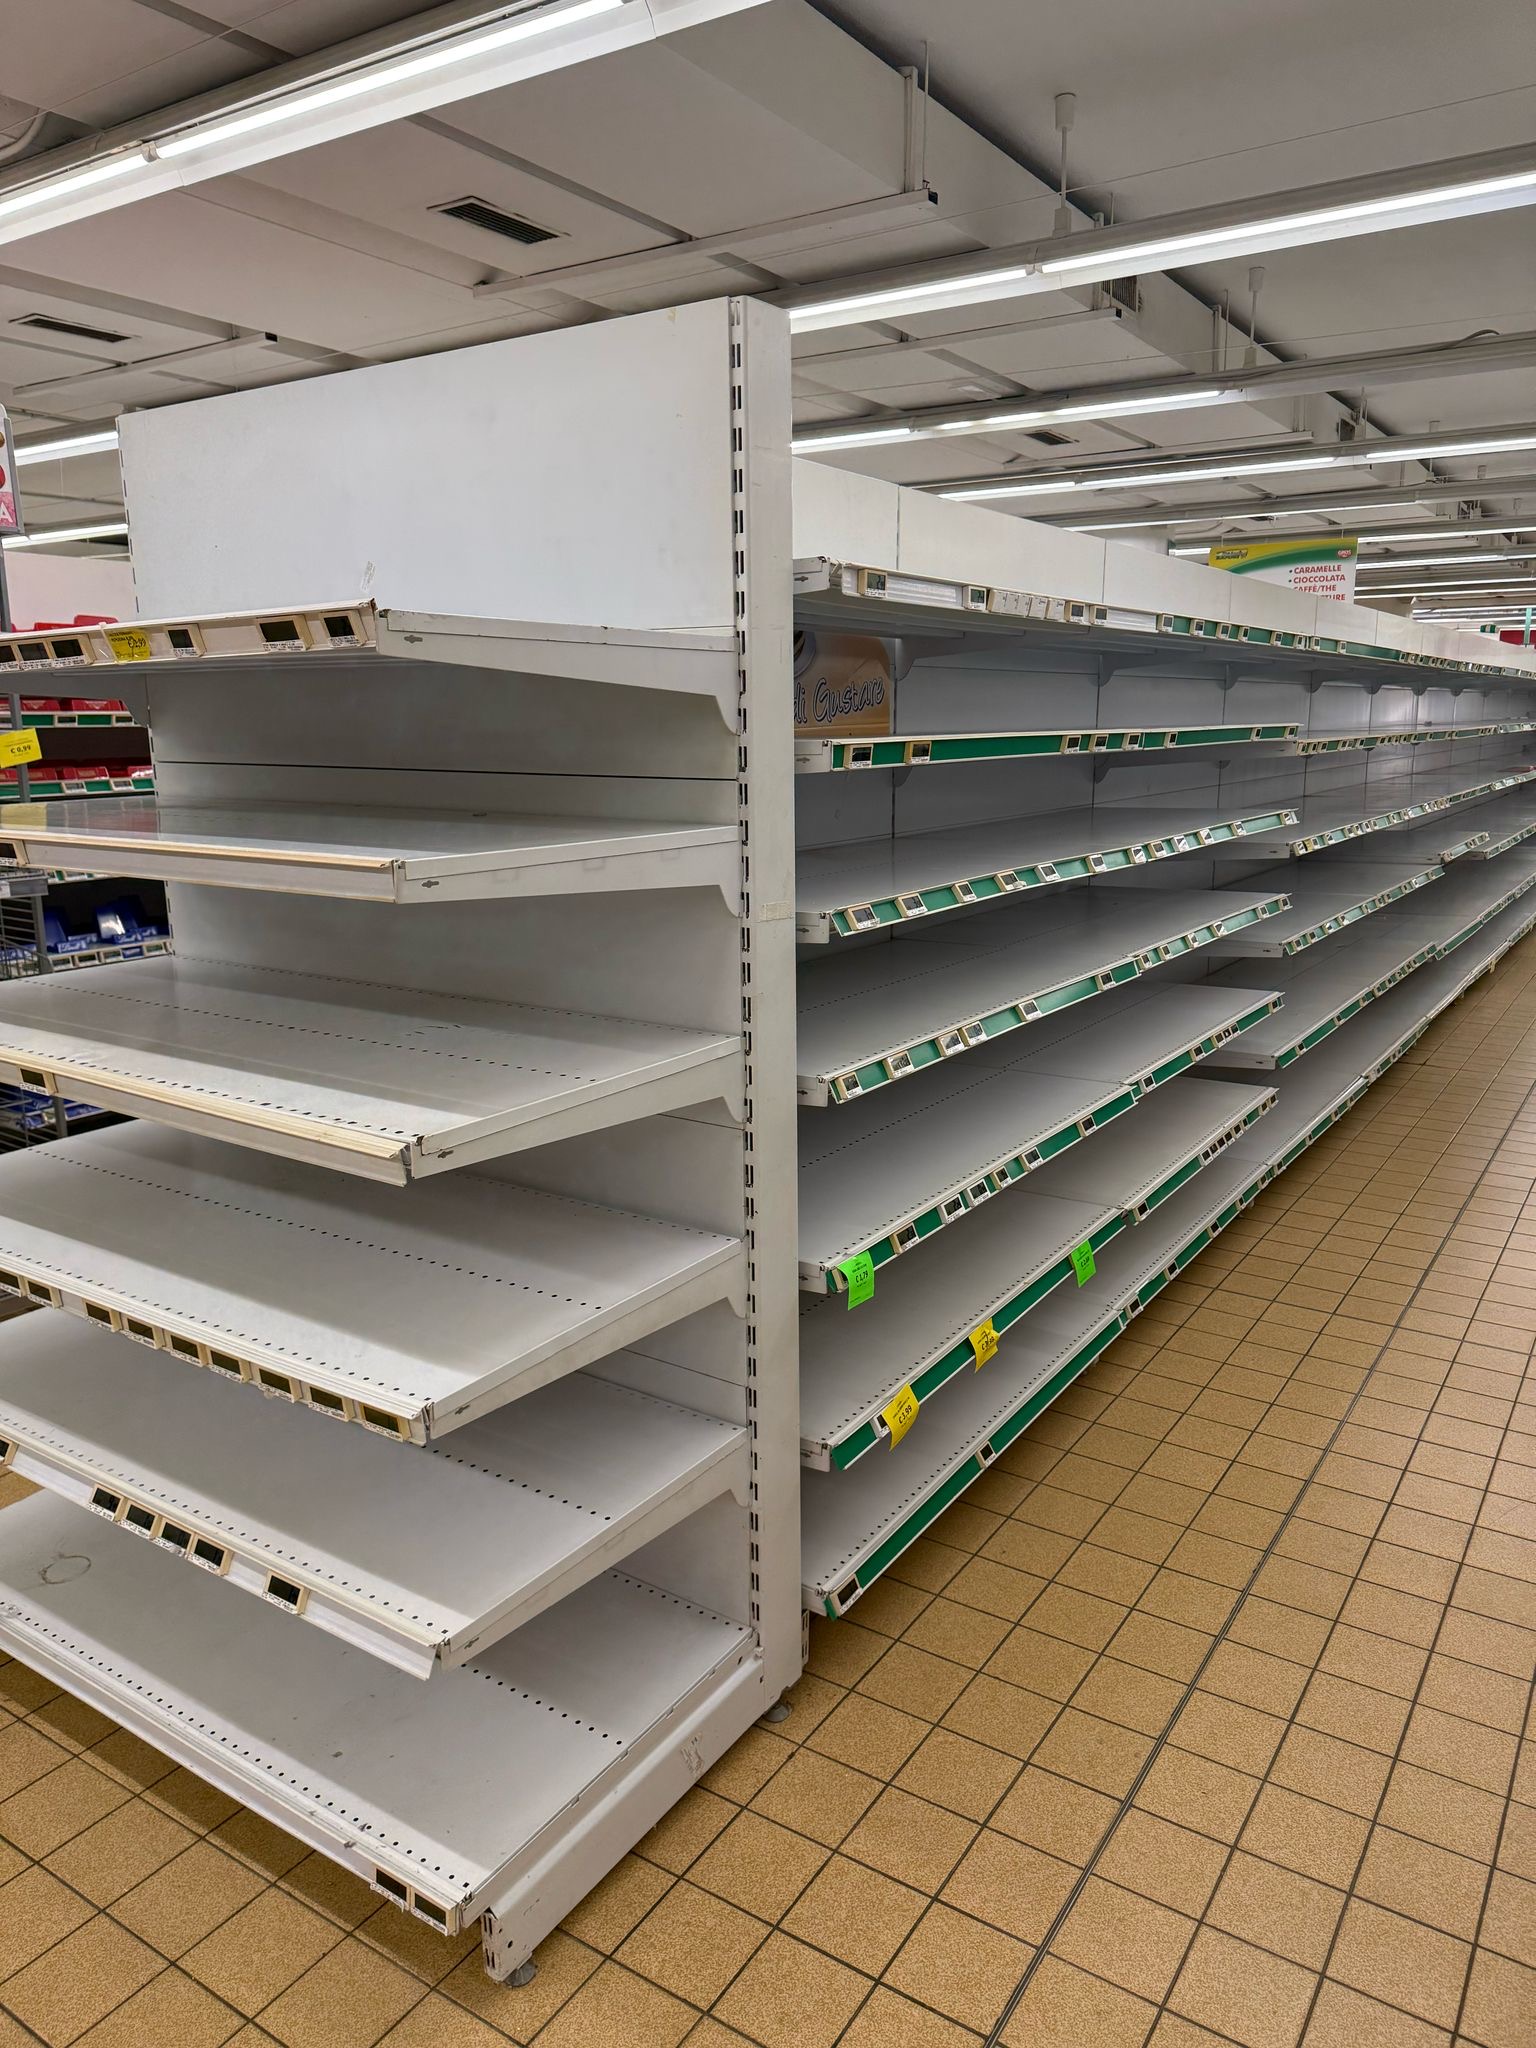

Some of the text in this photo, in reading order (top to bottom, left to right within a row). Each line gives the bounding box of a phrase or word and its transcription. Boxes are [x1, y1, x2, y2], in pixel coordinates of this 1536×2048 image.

[1294, 564, 1342, 575] CARAMELLE
[1293, 574, 1346, 584] CIOCCOLATA
[813, 677, 885, 723] Gustare
